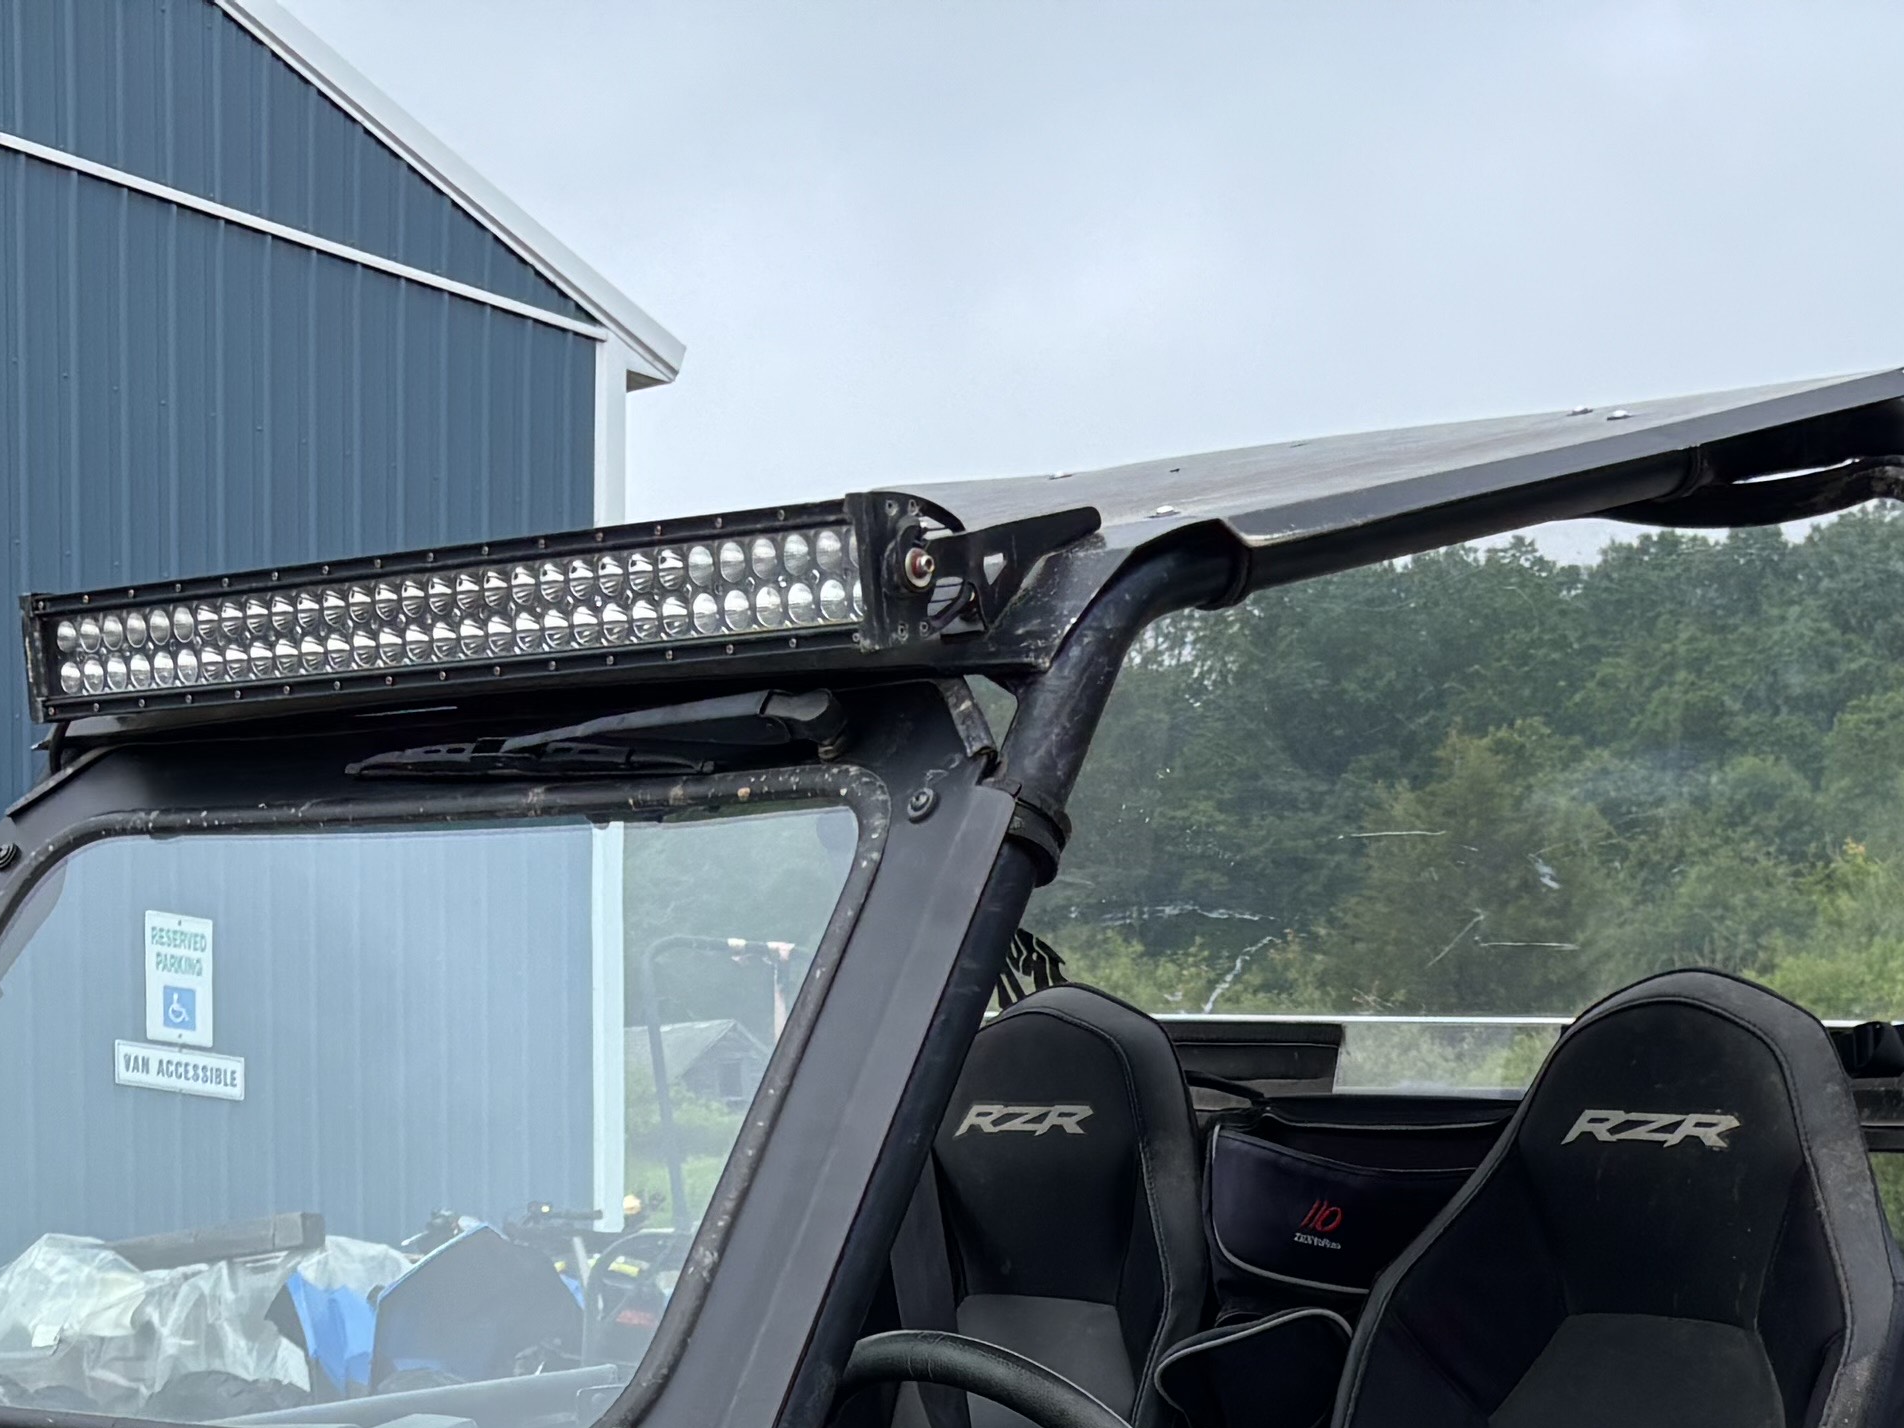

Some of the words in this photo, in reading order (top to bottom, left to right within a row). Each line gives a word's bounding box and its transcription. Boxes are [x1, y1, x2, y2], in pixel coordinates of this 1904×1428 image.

[151, 926, 207, 953] RESERVED
[155, 951, 203, 977] PARKING
[123, 1052, 150, 1075] VAN
[157, 1058, 238, 1088] ACCESSIBLE
[953, 1104, 1094, 1137] RZR
[1561, 1109, 1741, 1150] RZR
